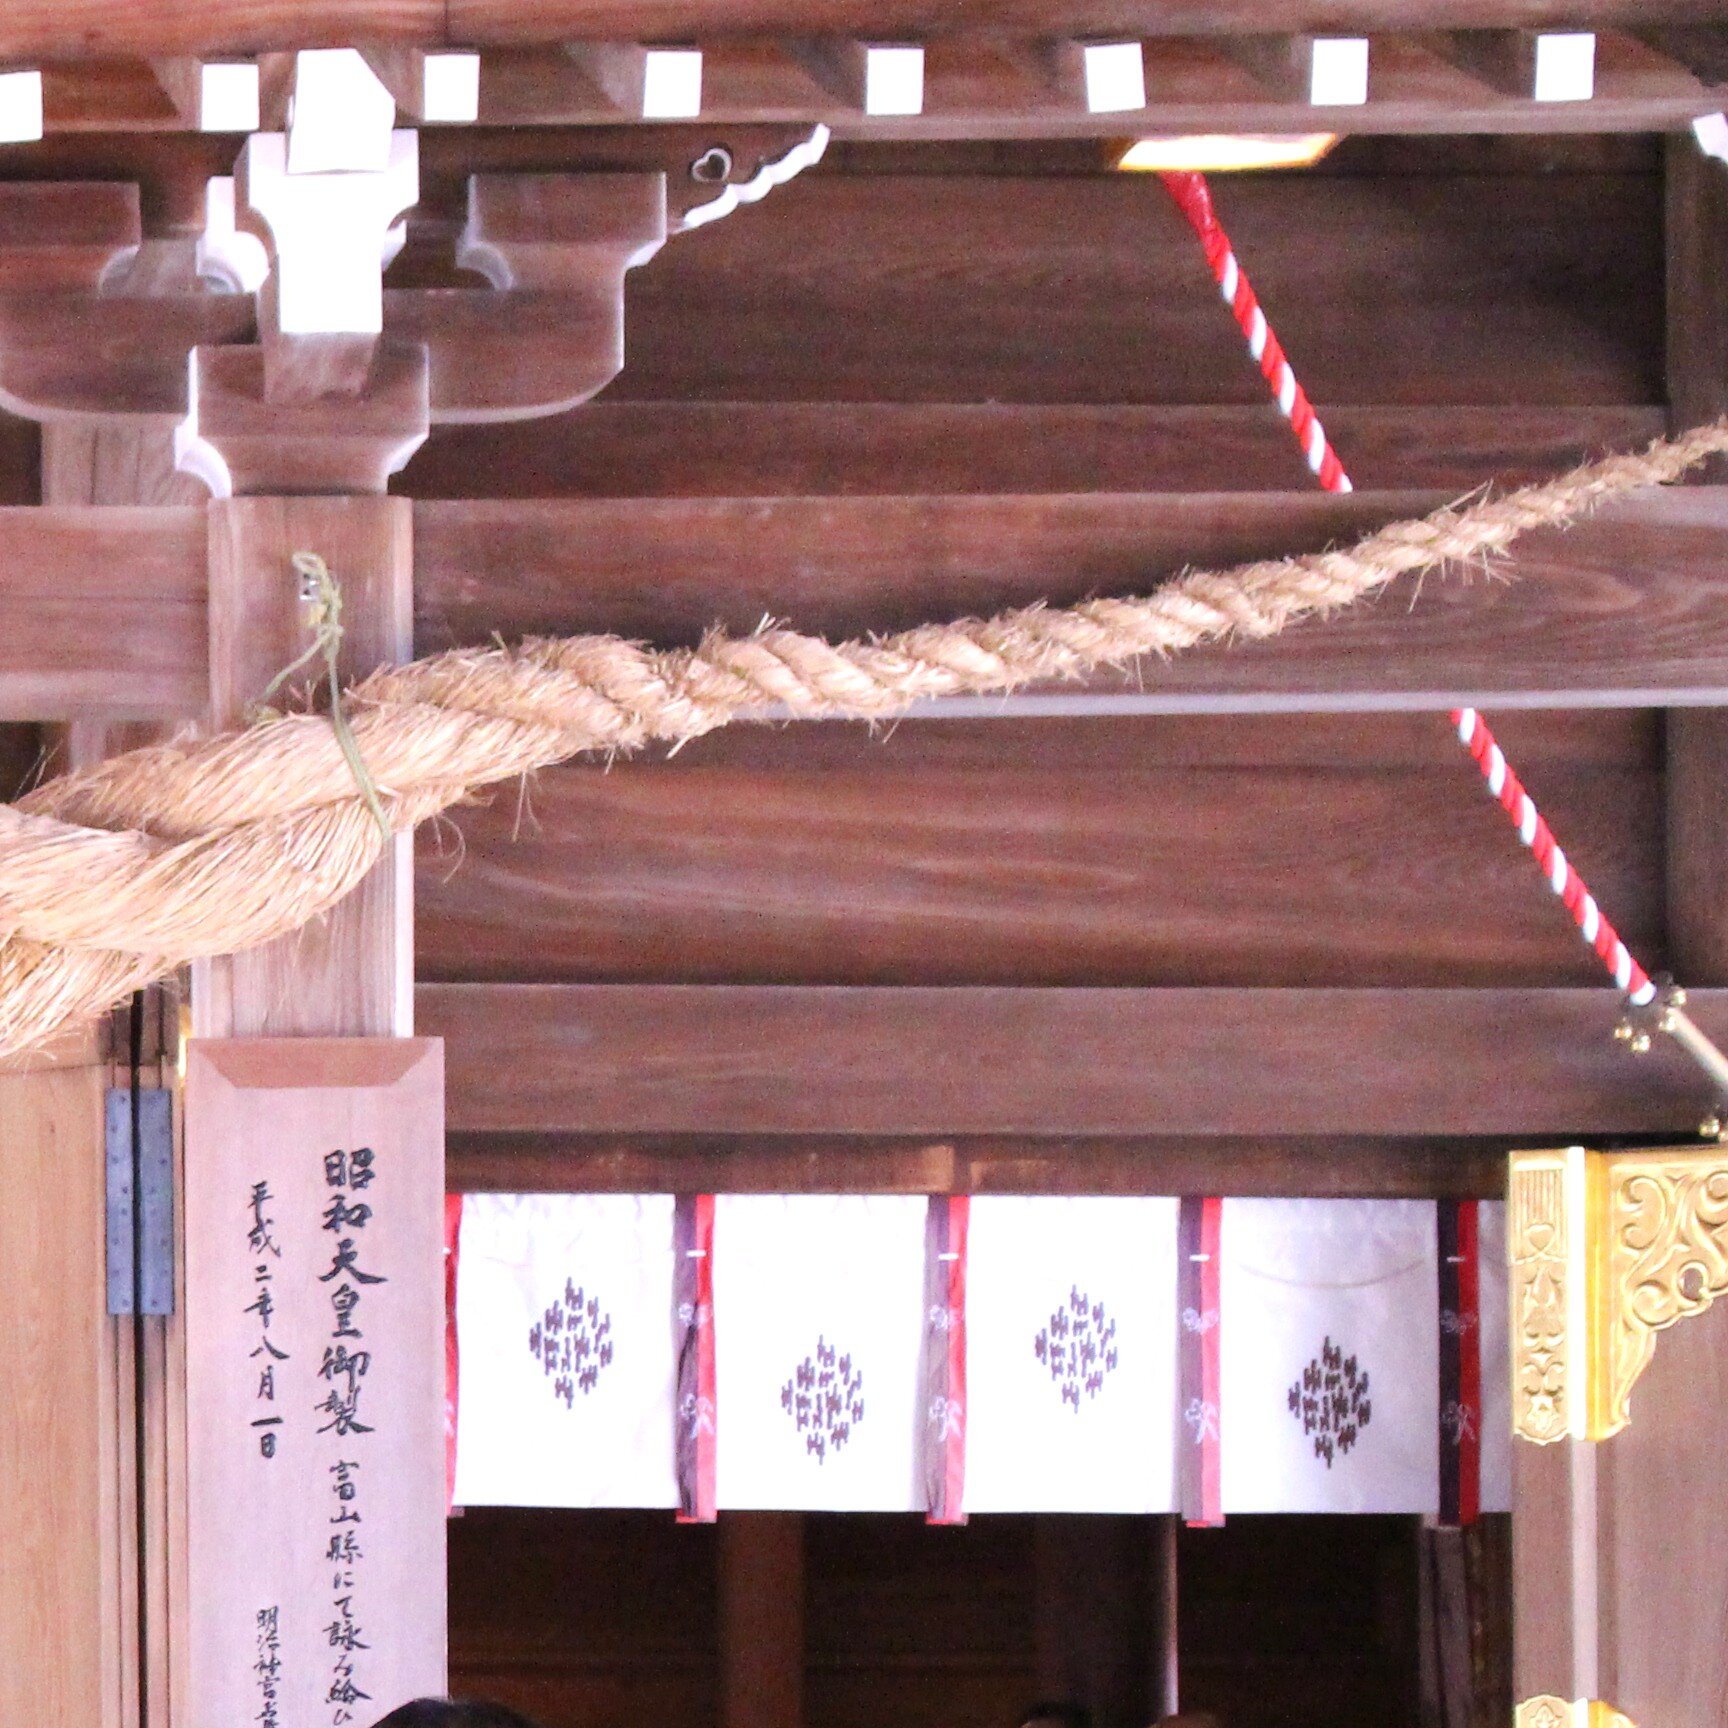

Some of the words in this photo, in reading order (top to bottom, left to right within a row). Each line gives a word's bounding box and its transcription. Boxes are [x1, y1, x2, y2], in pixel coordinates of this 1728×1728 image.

[243, 1180, 290, 1459] 平成二年八月一日
[314, 1147, 388, 1436] 昭和天皇御製
